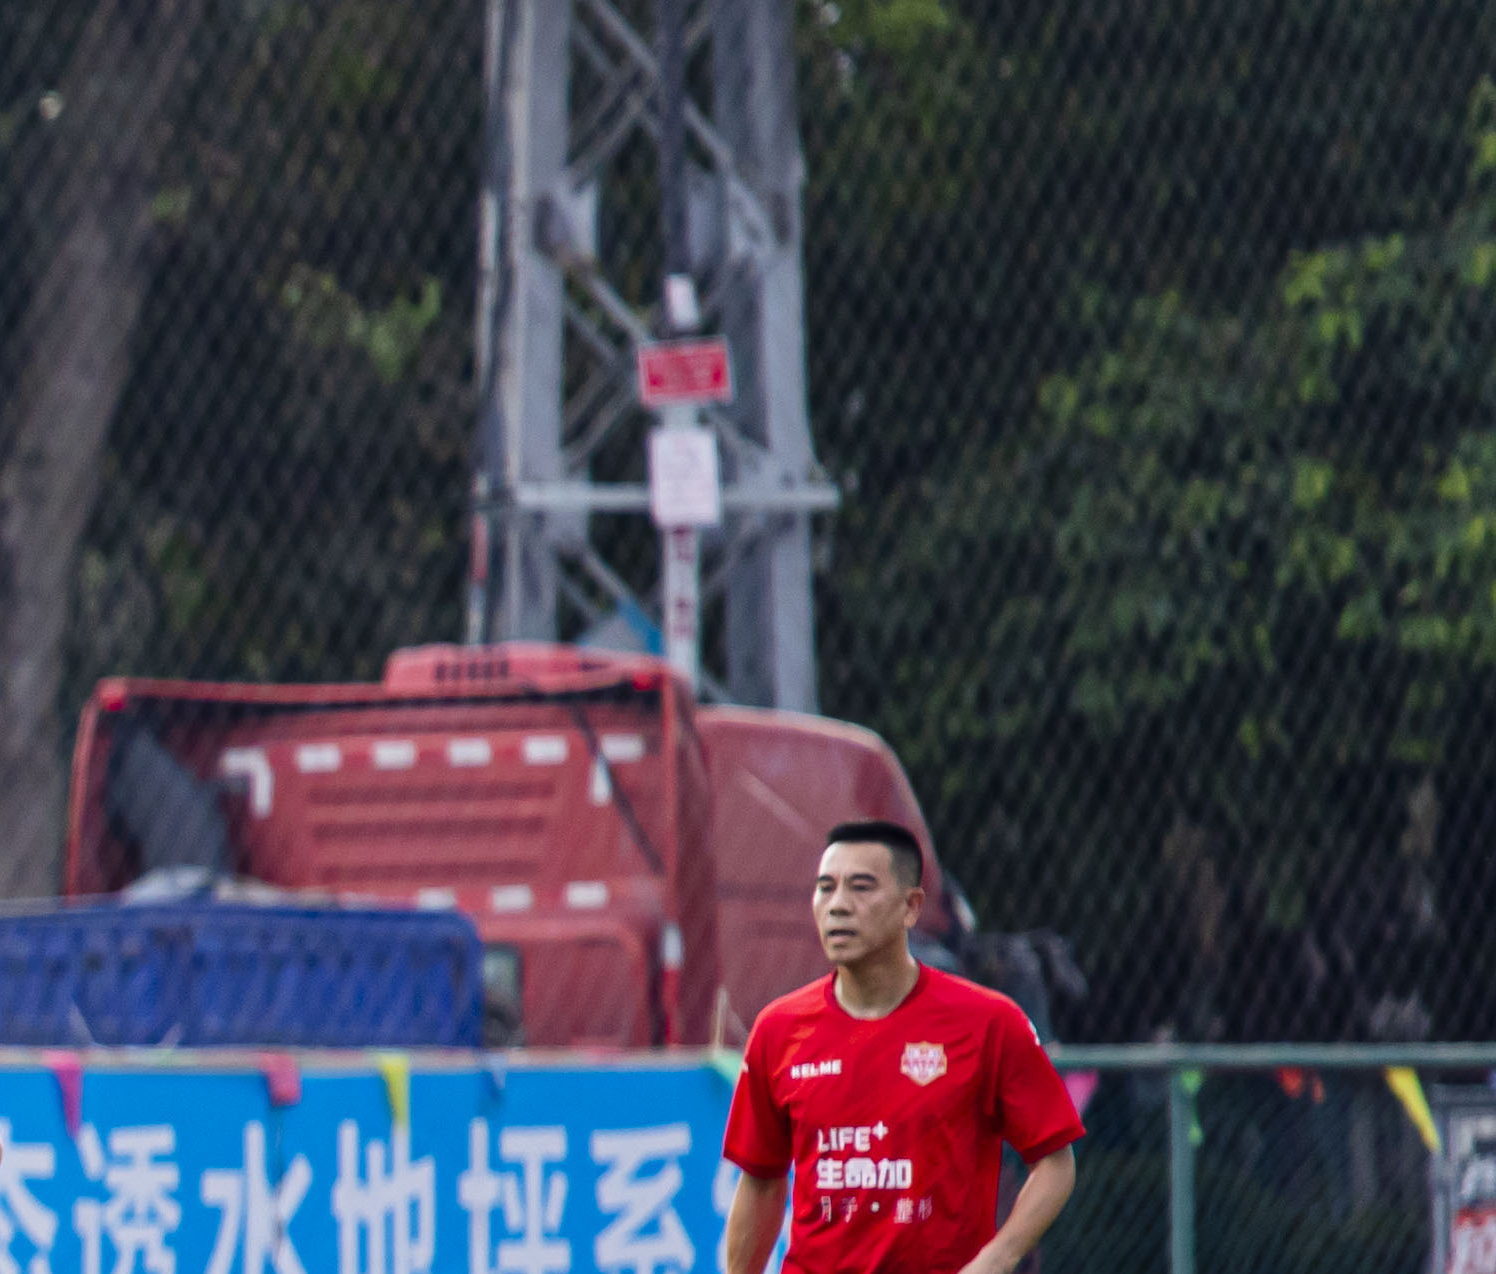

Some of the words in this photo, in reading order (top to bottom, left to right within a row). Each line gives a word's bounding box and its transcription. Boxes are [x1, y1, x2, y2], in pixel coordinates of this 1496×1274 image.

[791, 1059, 842, 1080] KELME
[817, 1120, 889, 1153] LIFE+
[816, 1157, 913, 1189] 生命加
